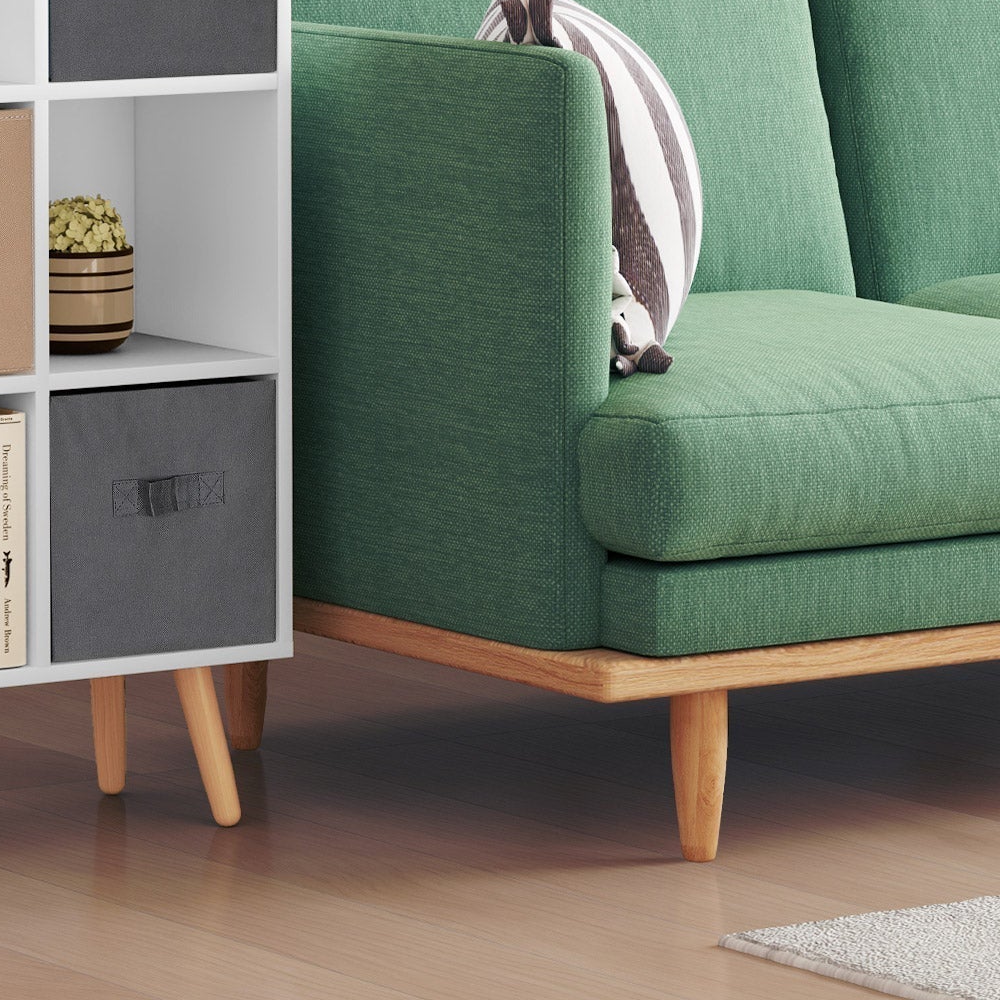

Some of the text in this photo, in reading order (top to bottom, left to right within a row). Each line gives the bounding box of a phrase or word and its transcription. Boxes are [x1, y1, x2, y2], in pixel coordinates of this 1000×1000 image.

[0, 444, 12, 541] Dreaming of Sweden
[3, 598, 12, 654] Andrew Brown
